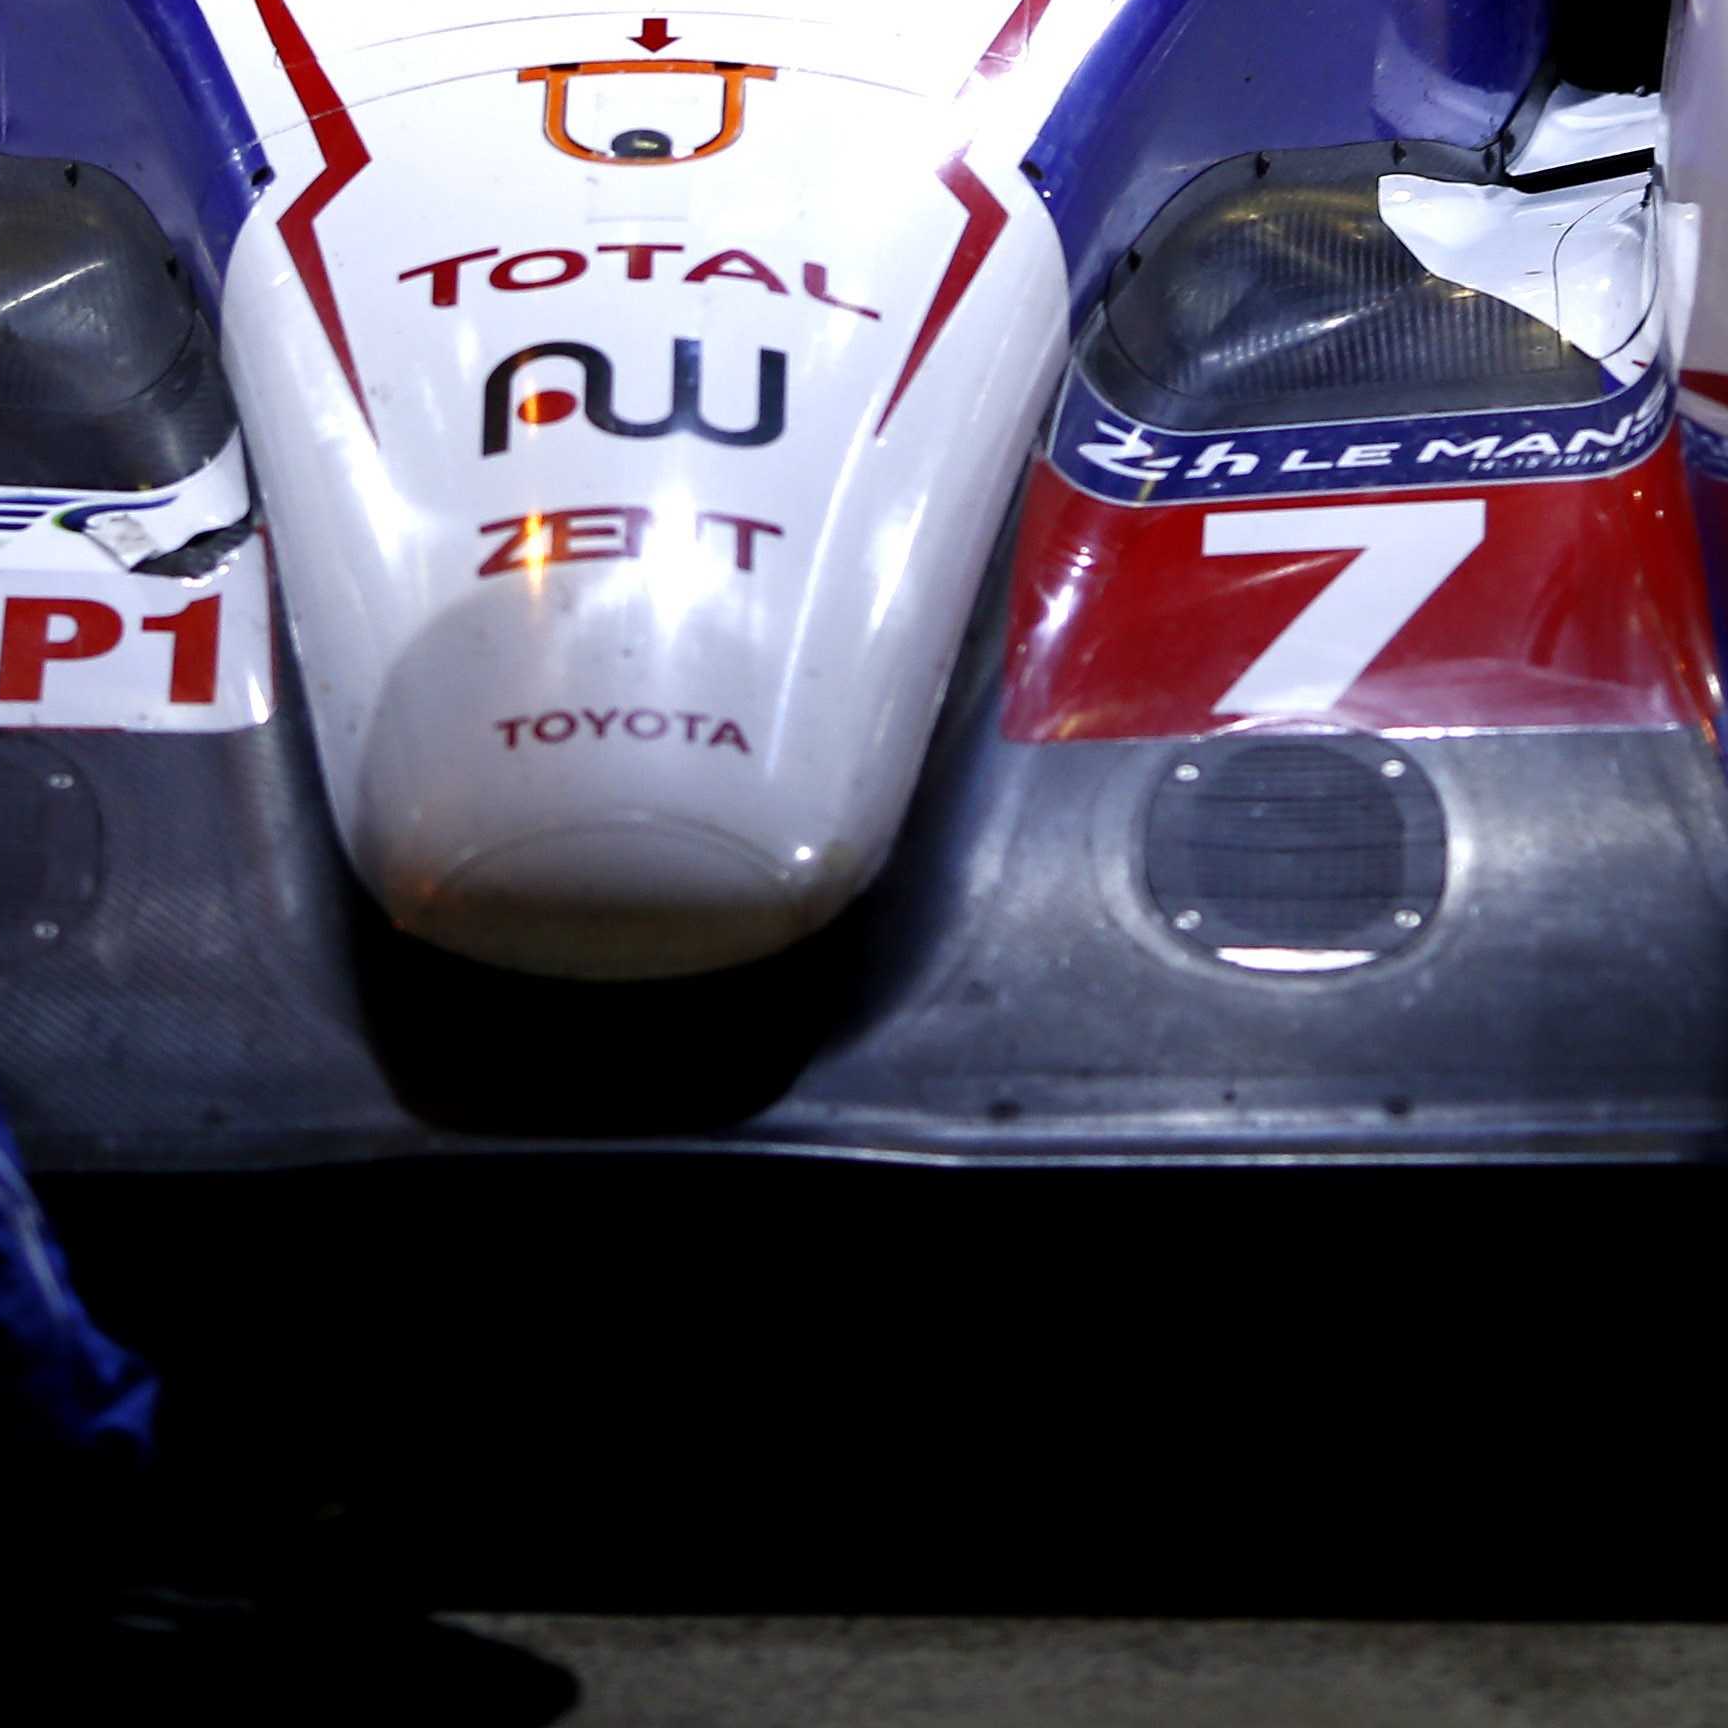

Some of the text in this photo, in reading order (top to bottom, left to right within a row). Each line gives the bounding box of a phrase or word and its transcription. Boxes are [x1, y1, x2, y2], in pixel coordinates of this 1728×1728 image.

[398, 244, 881, 321] TOTAL
[1279, 442, 1402, 472] LE
[1415, 374, 1668, 465] MANS
[1201, 498, 1488, 717] 7
[496, 707, 751, 754] TOYOTA
